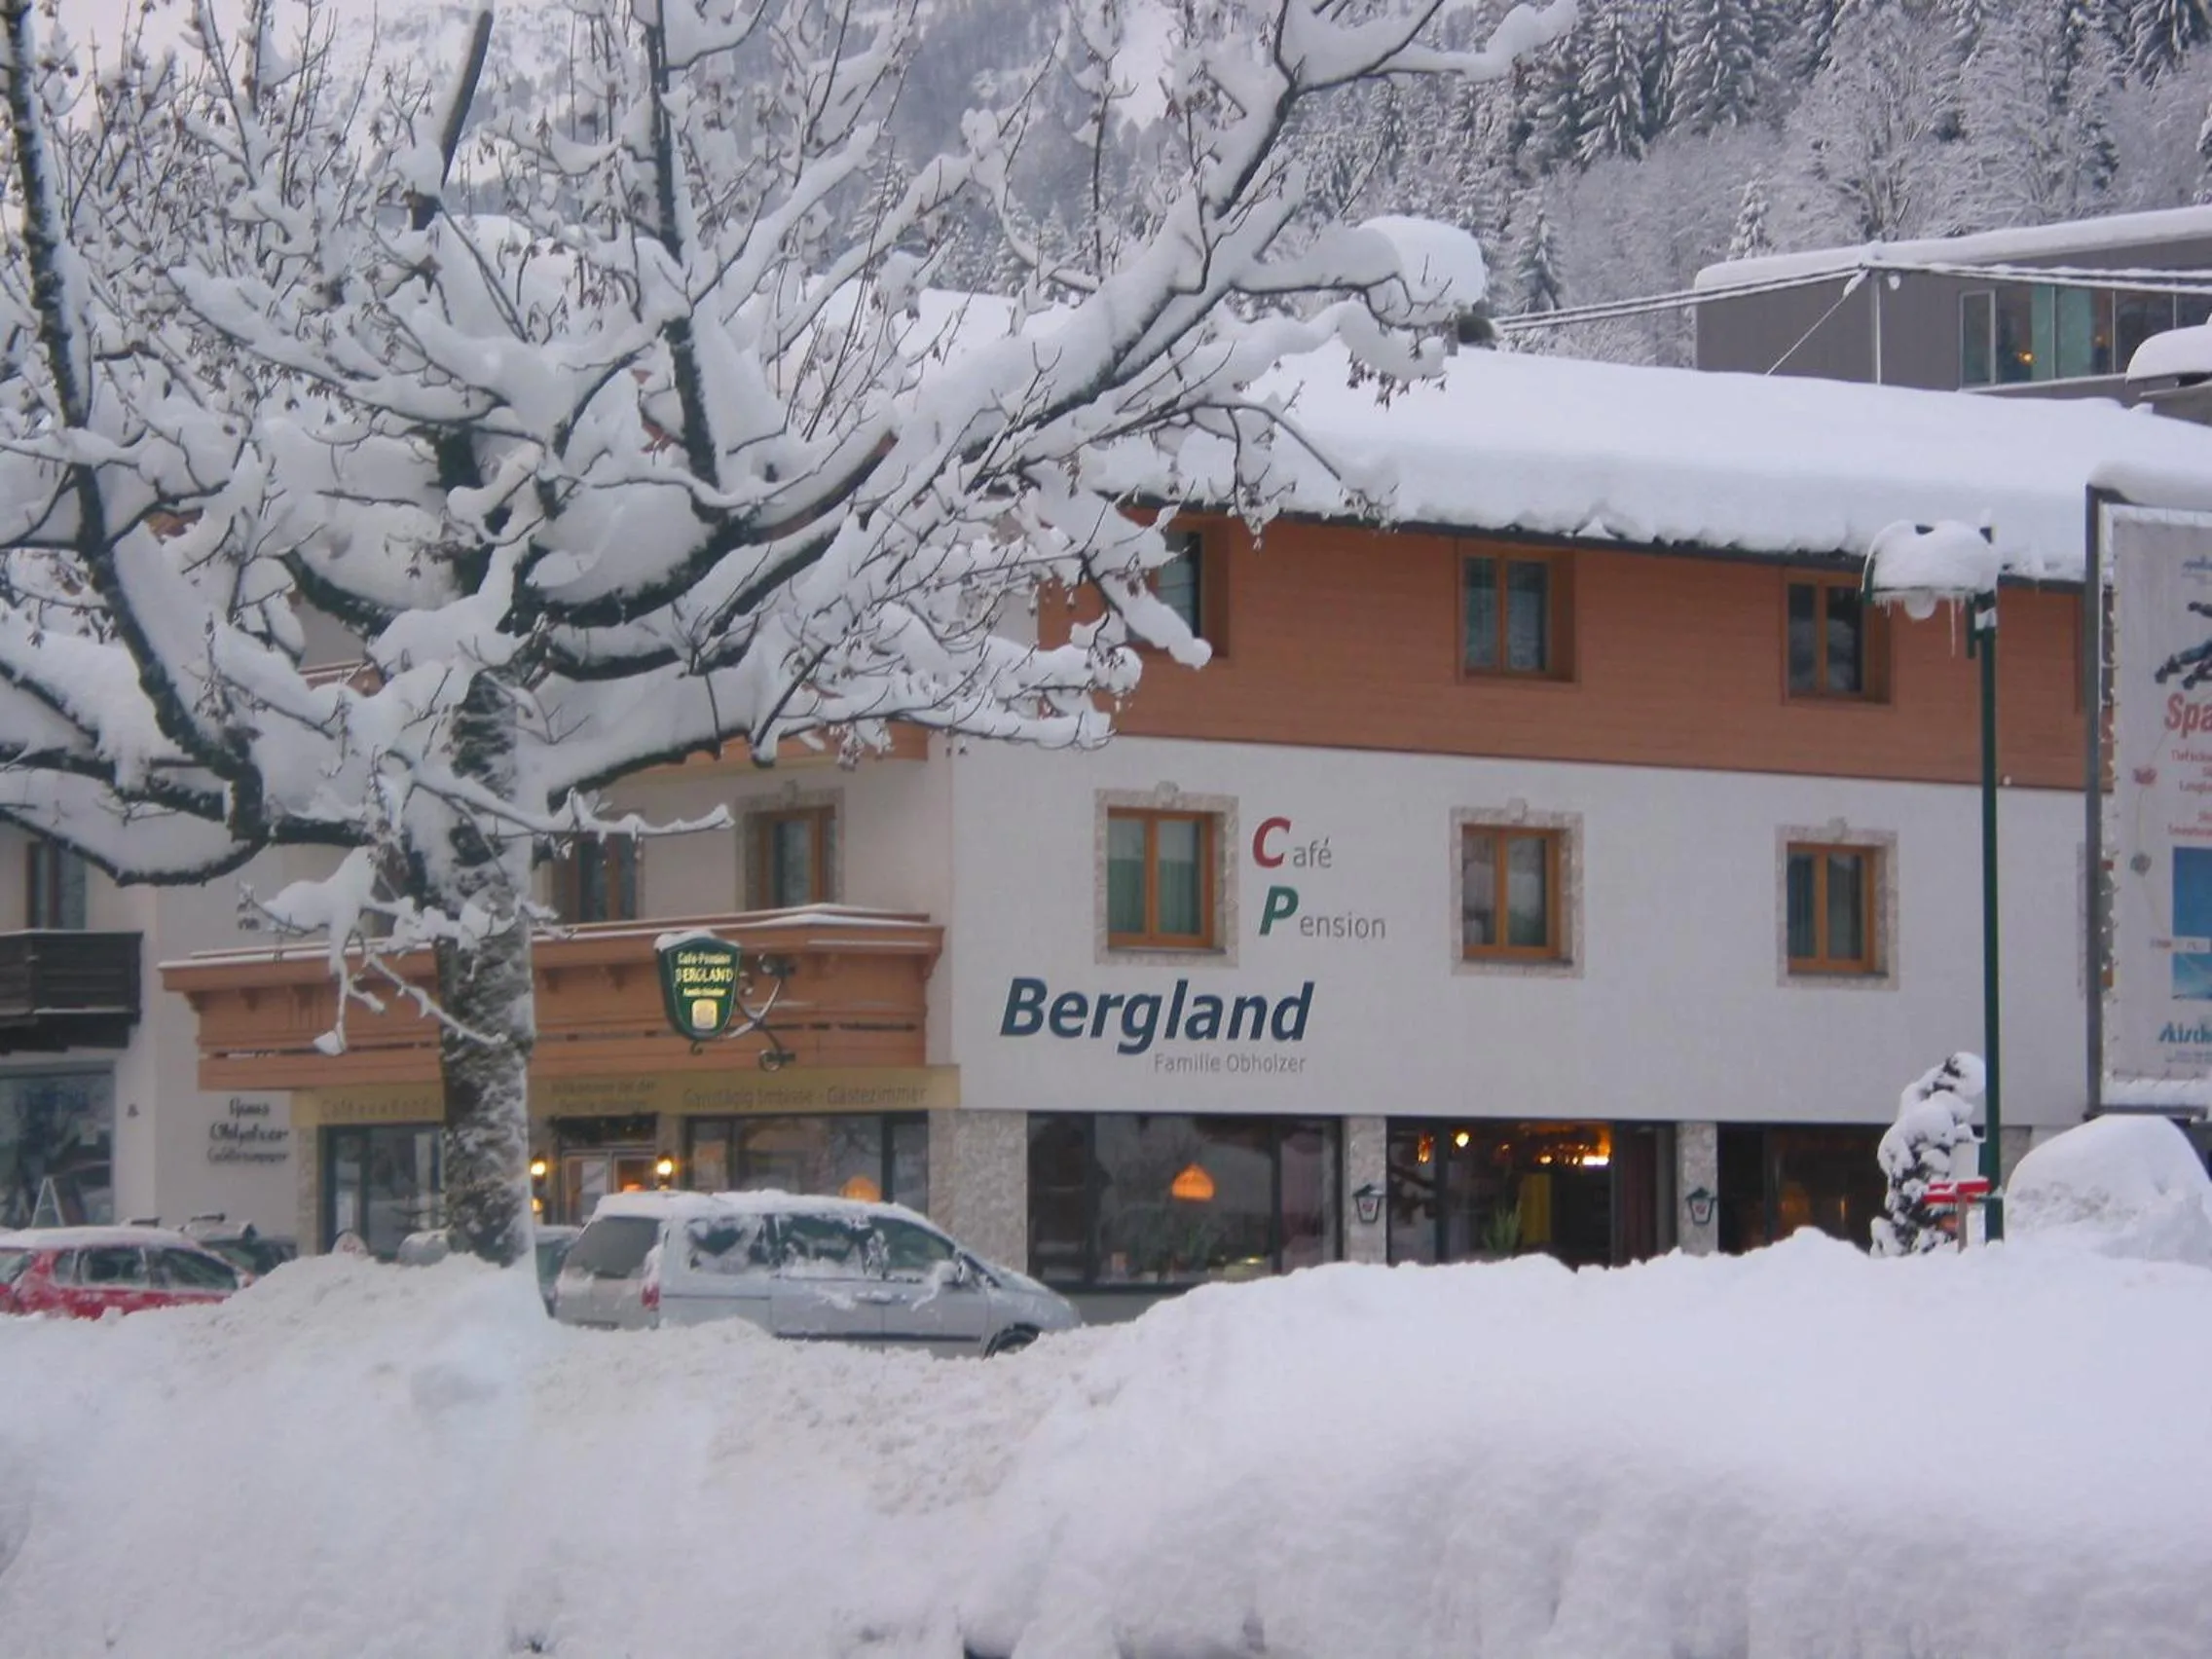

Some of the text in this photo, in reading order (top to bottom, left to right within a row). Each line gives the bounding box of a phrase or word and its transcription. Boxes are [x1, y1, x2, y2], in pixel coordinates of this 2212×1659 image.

[1252, 816, 1332, 868] Café
[1259, 886, 1386, 939] Pension
[675, 967, 734, 983] BERGLAND
[1000, 977, 1315, 1054] Bergland
[1154, 1054, 1306, 1075] Familie Obholzer
